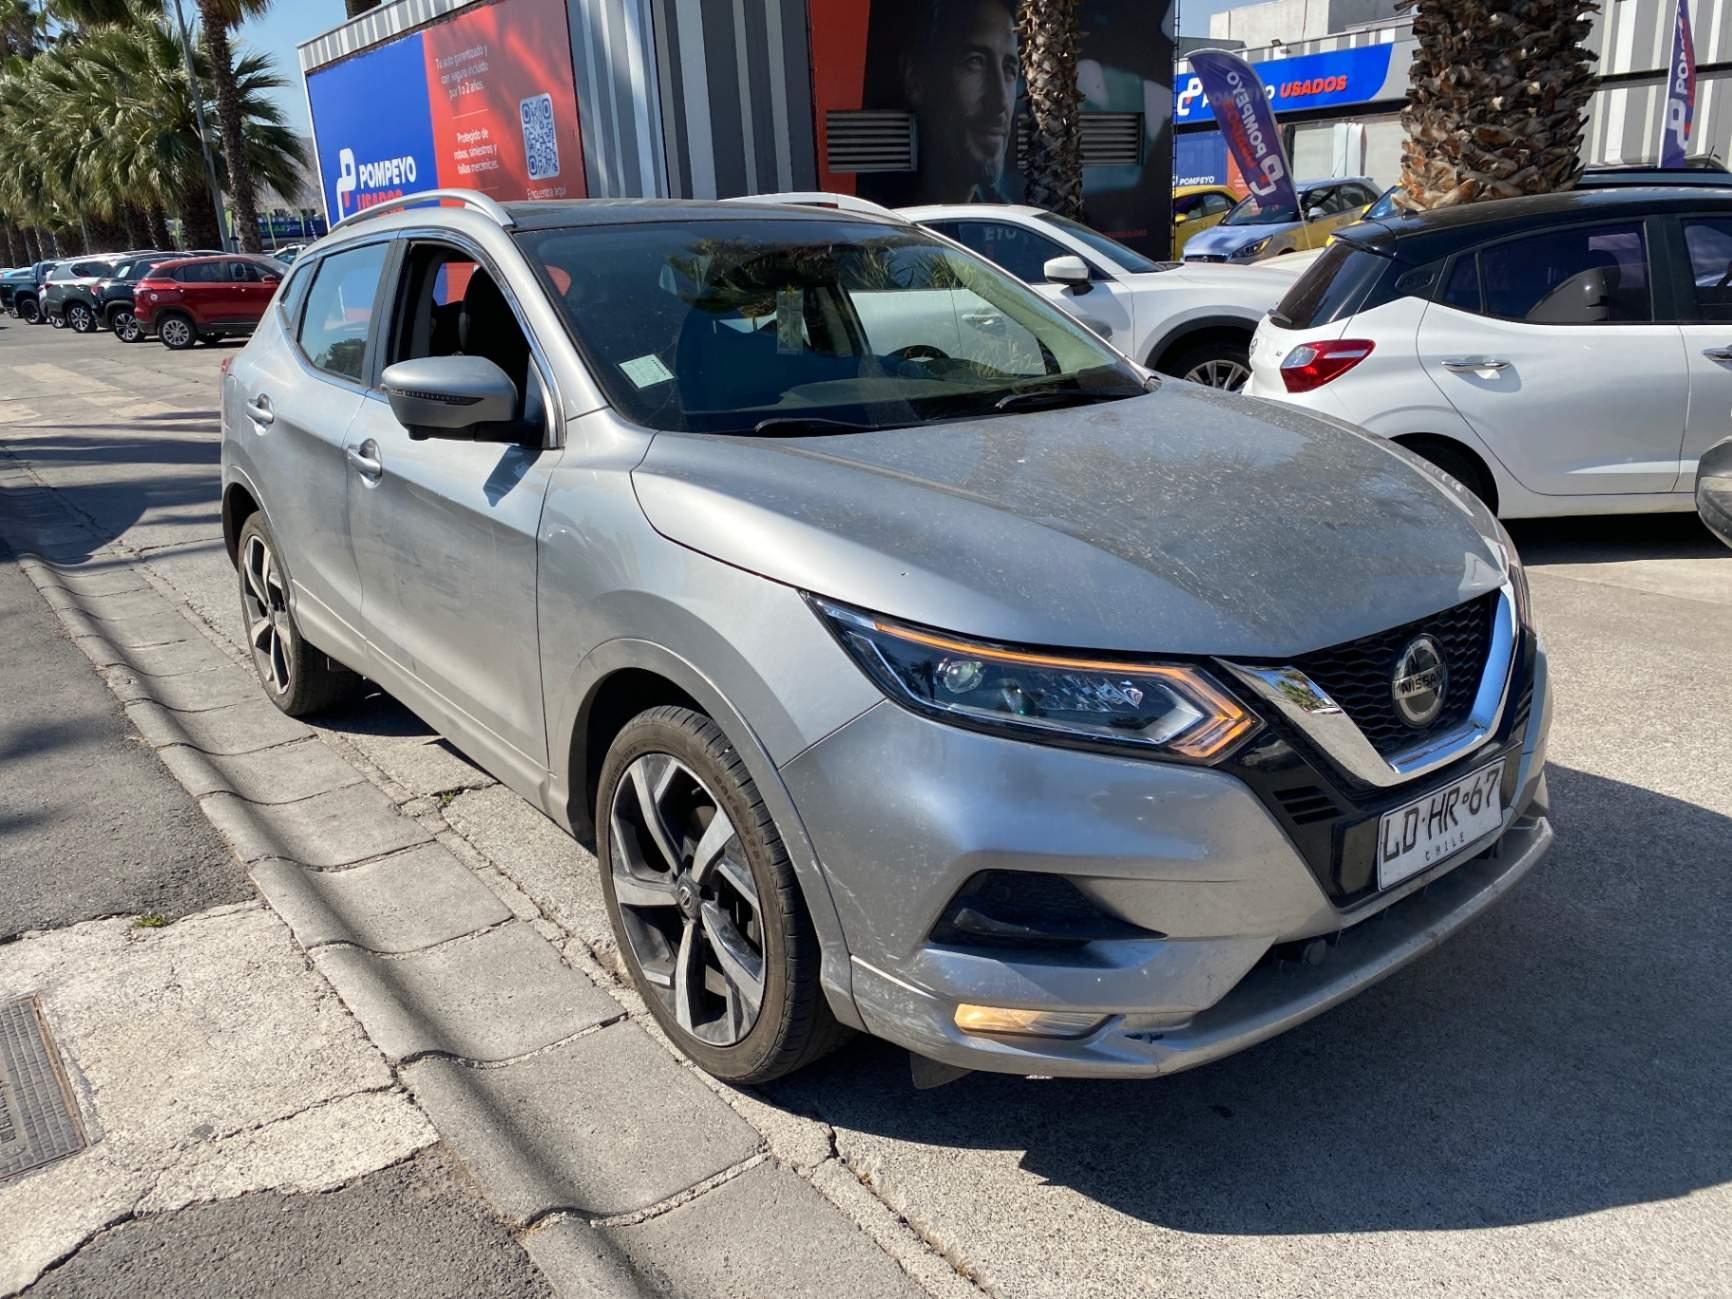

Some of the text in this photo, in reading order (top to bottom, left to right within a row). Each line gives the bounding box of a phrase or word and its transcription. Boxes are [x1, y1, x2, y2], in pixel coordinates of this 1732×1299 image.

[1280, 75, 1347, 98] USADOS
[359, 156, 416, 190] POMPEYO
[1425, 832, 1465, 862] CHILE
